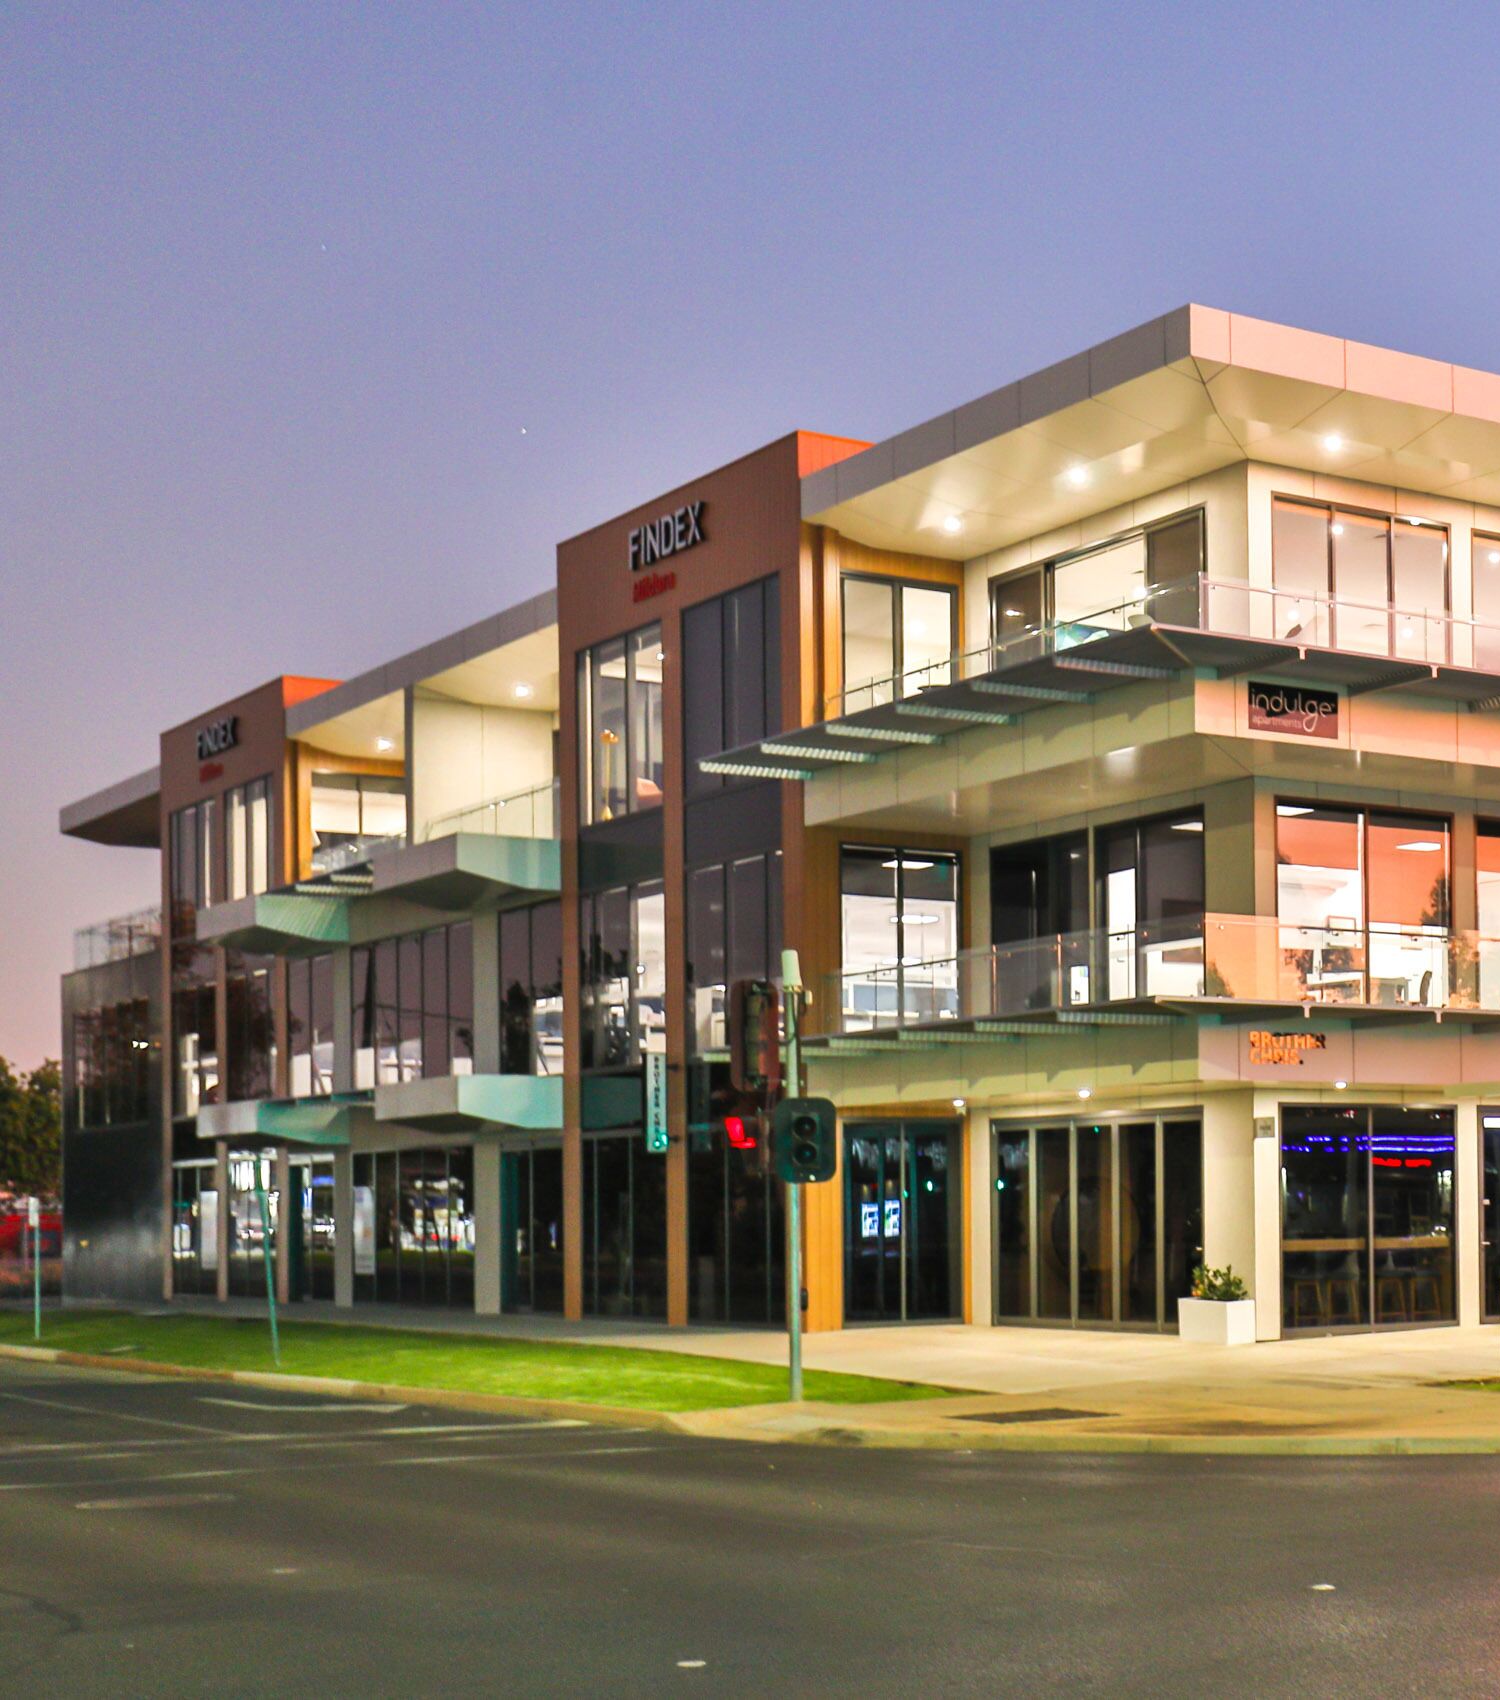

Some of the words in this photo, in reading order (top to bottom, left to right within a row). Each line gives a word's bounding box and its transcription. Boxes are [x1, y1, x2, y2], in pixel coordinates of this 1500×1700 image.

[628, 501, 703, 571] FINDEX
[1252, 688, 1332, 732] indulge
[197, 714, 239, 760] FINDEX
[1249, 1031, 1326, 1049] BROTHER
